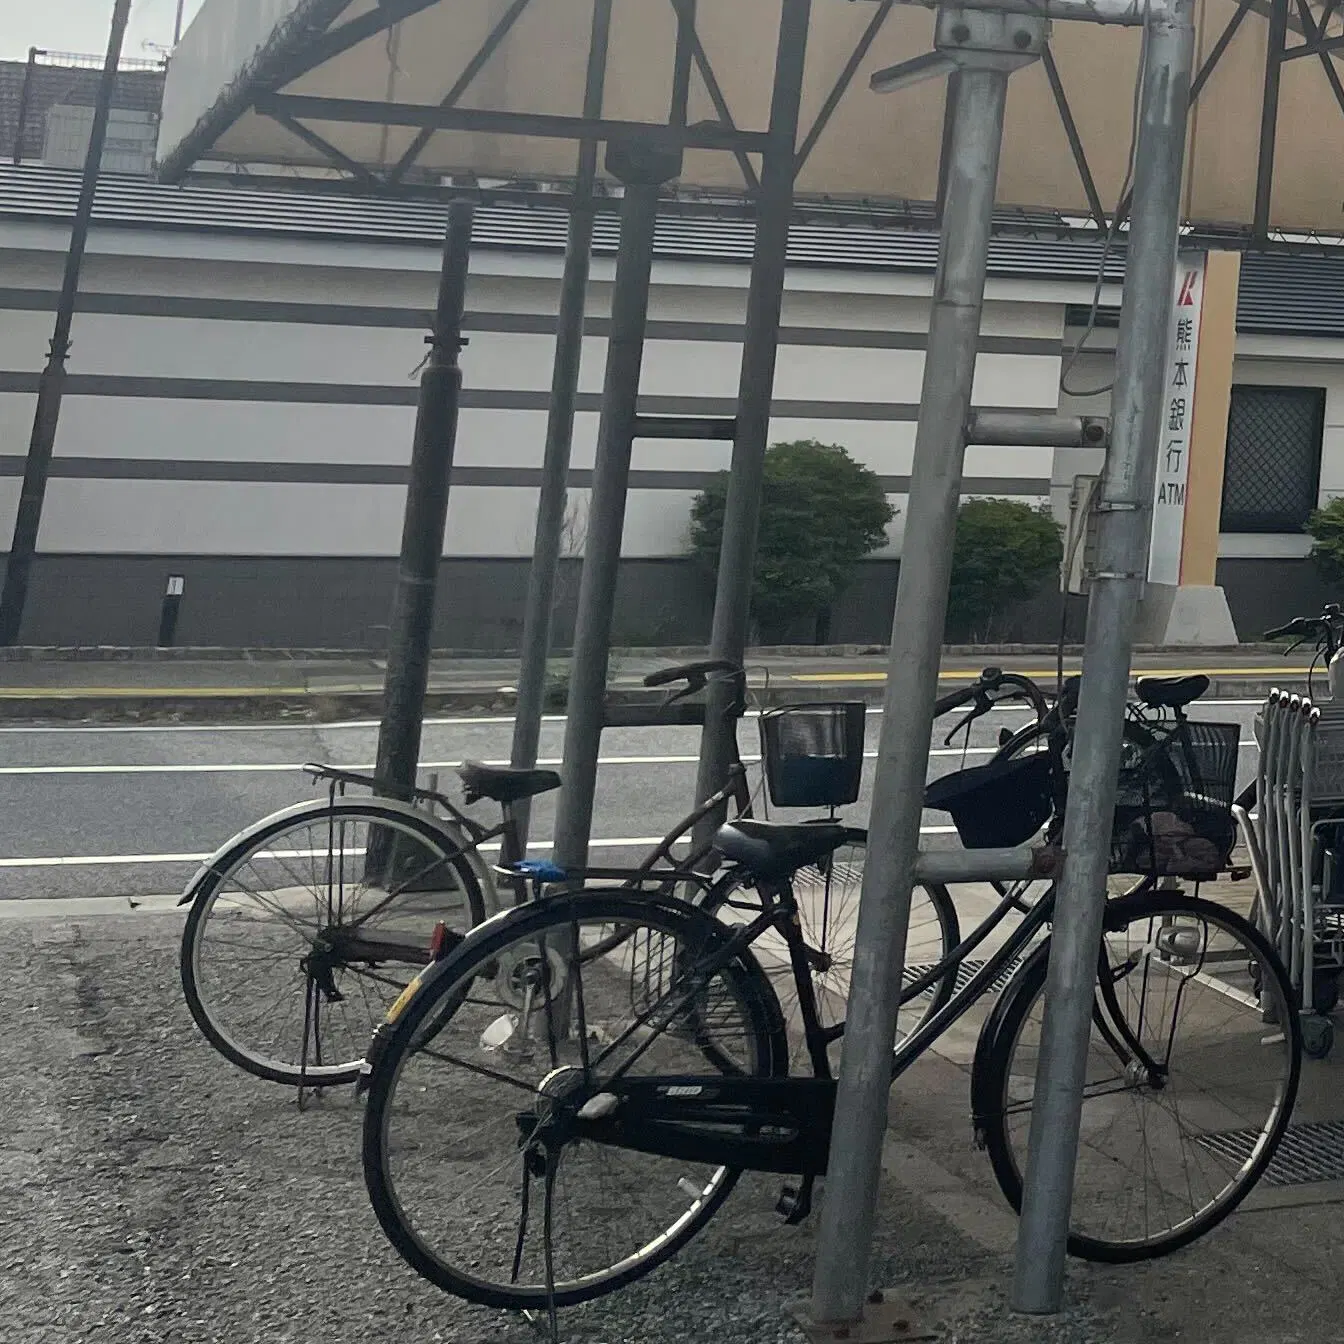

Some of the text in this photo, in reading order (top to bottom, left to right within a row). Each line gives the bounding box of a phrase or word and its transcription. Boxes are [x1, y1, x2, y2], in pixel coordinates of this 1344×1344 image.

[1158, 318, 1193, 506] 熊本銀行 ATM
